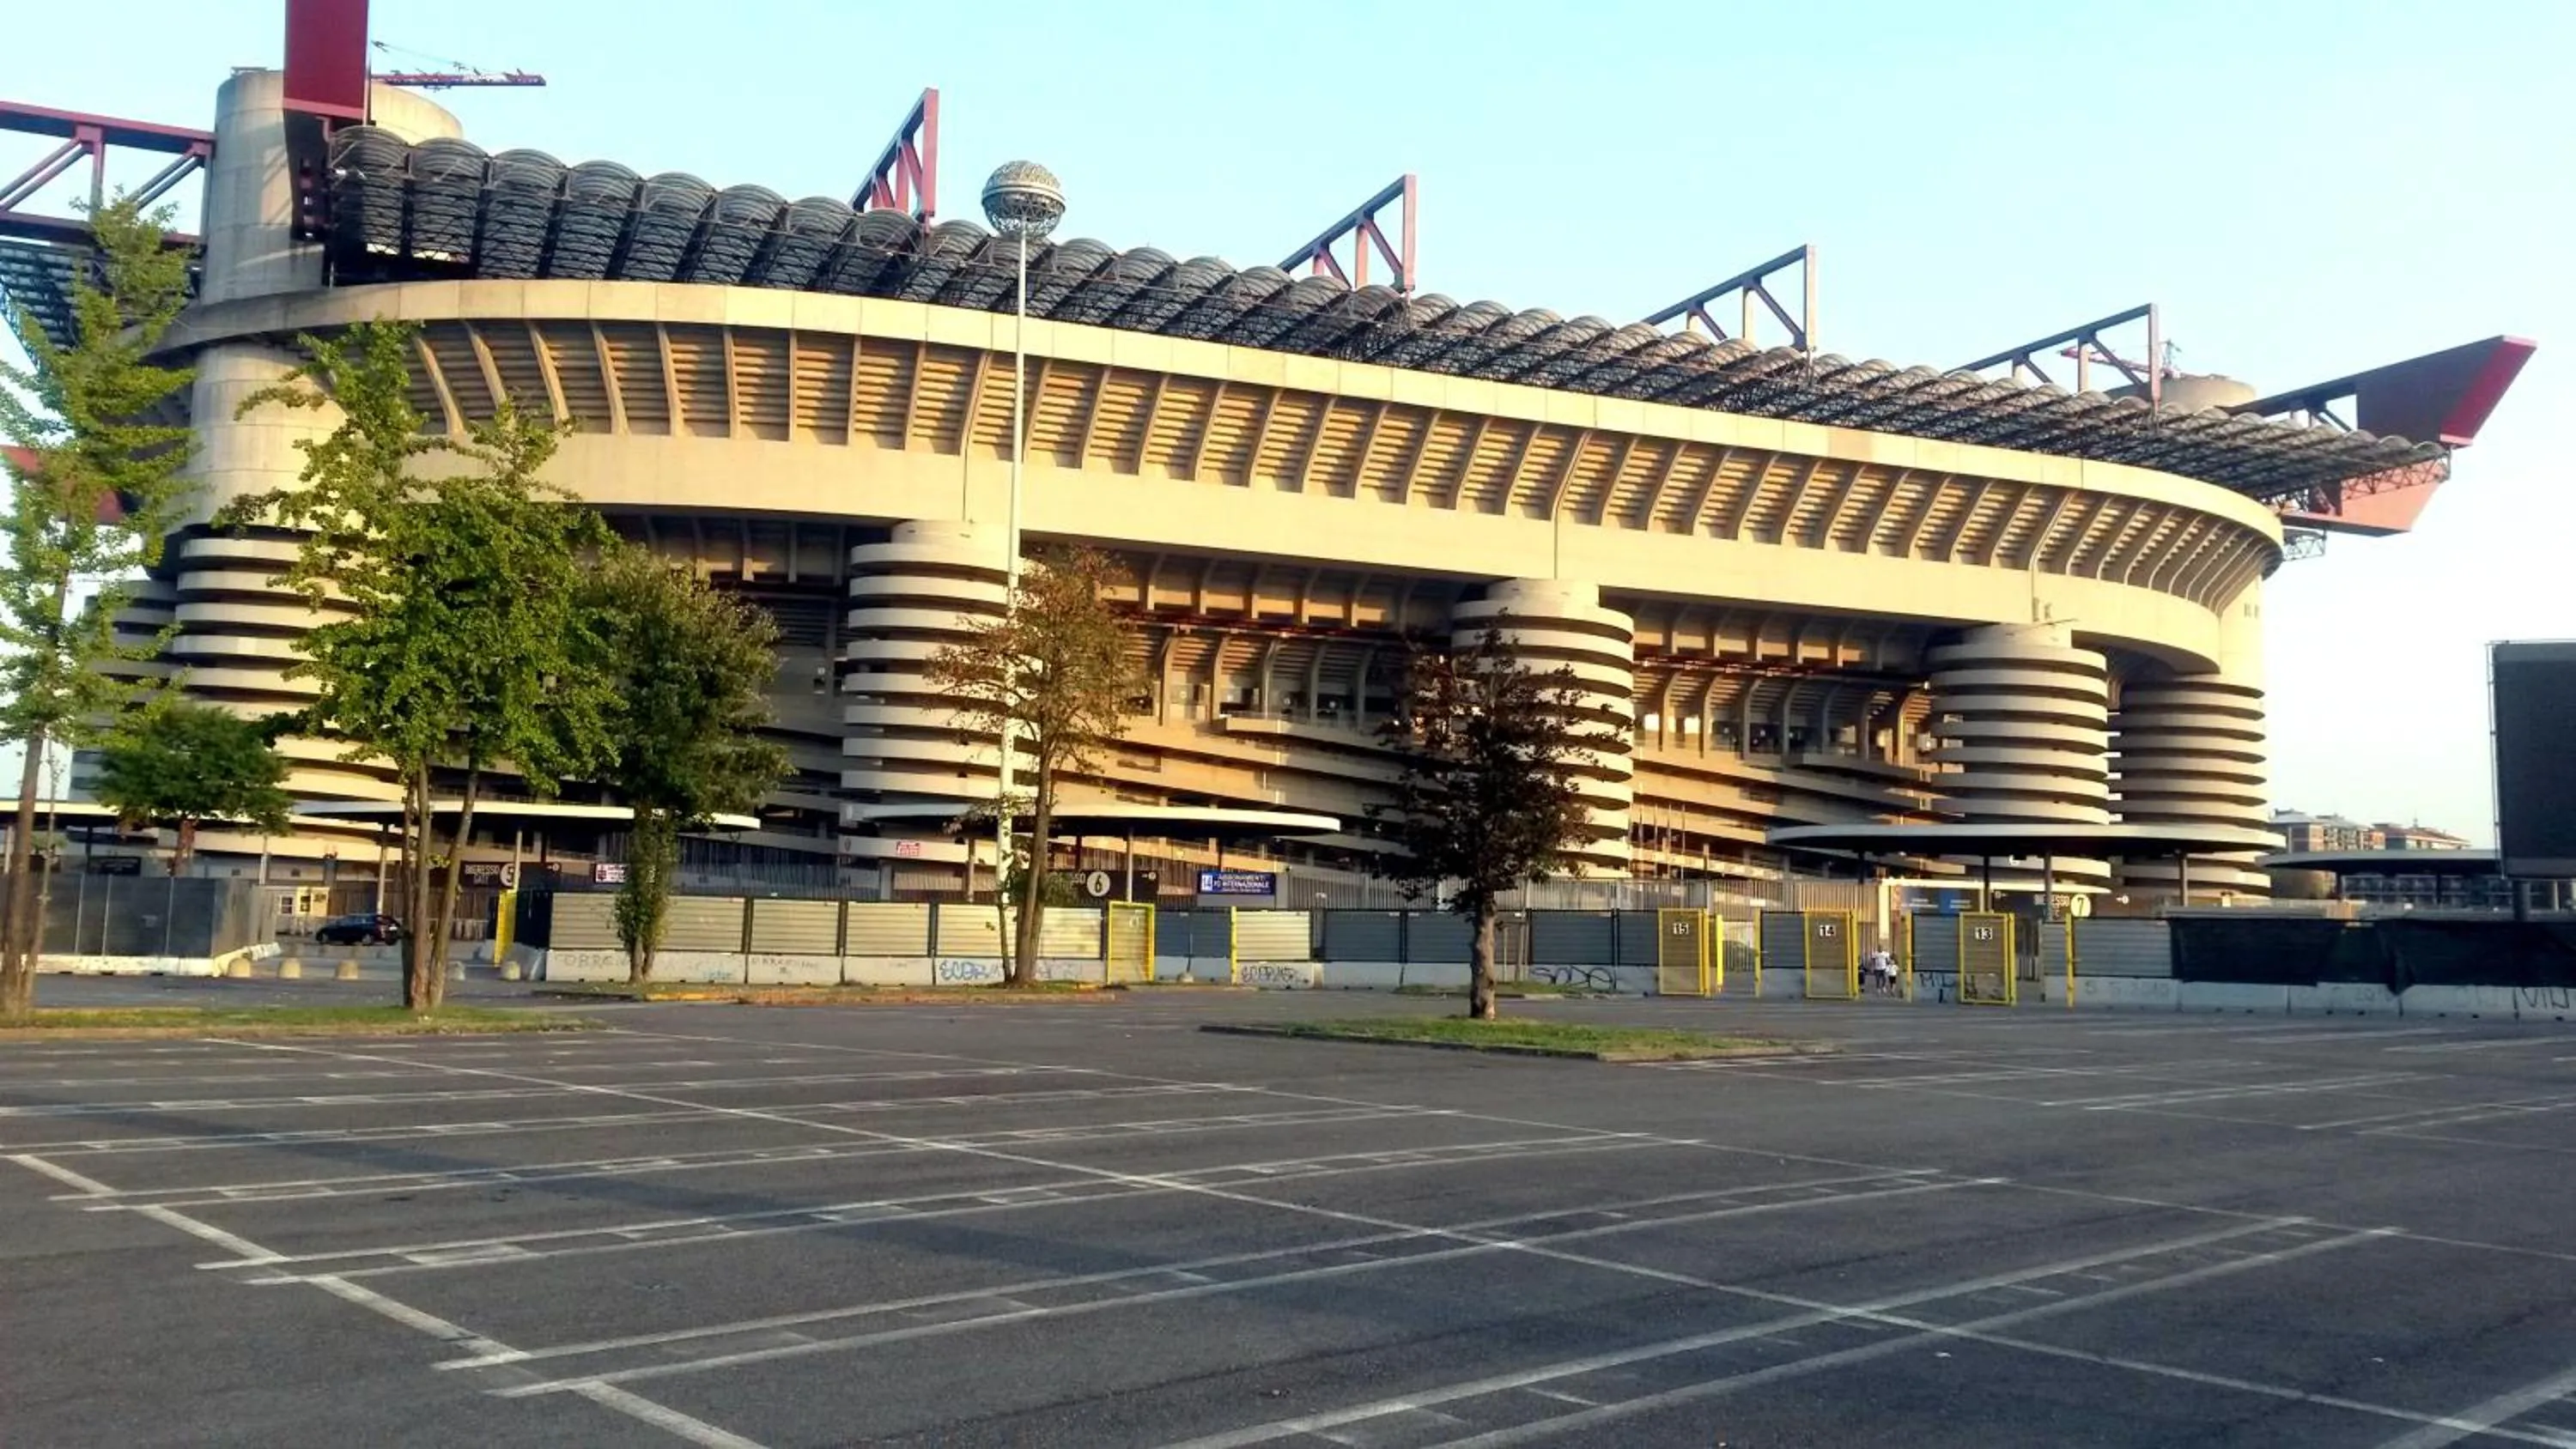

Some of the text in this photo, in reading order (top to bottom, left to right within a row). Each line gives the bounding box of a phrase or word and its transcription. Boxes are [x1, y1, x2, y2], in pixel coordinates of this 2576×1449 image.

[1095, 874, 1103, 894] 6
[2077, 897, 2085, 915] 7
[1674, 923, 1688, 935] 15
[1820, 925, 1835, 937] 14
[1977, 927, 1992, 939] 13
